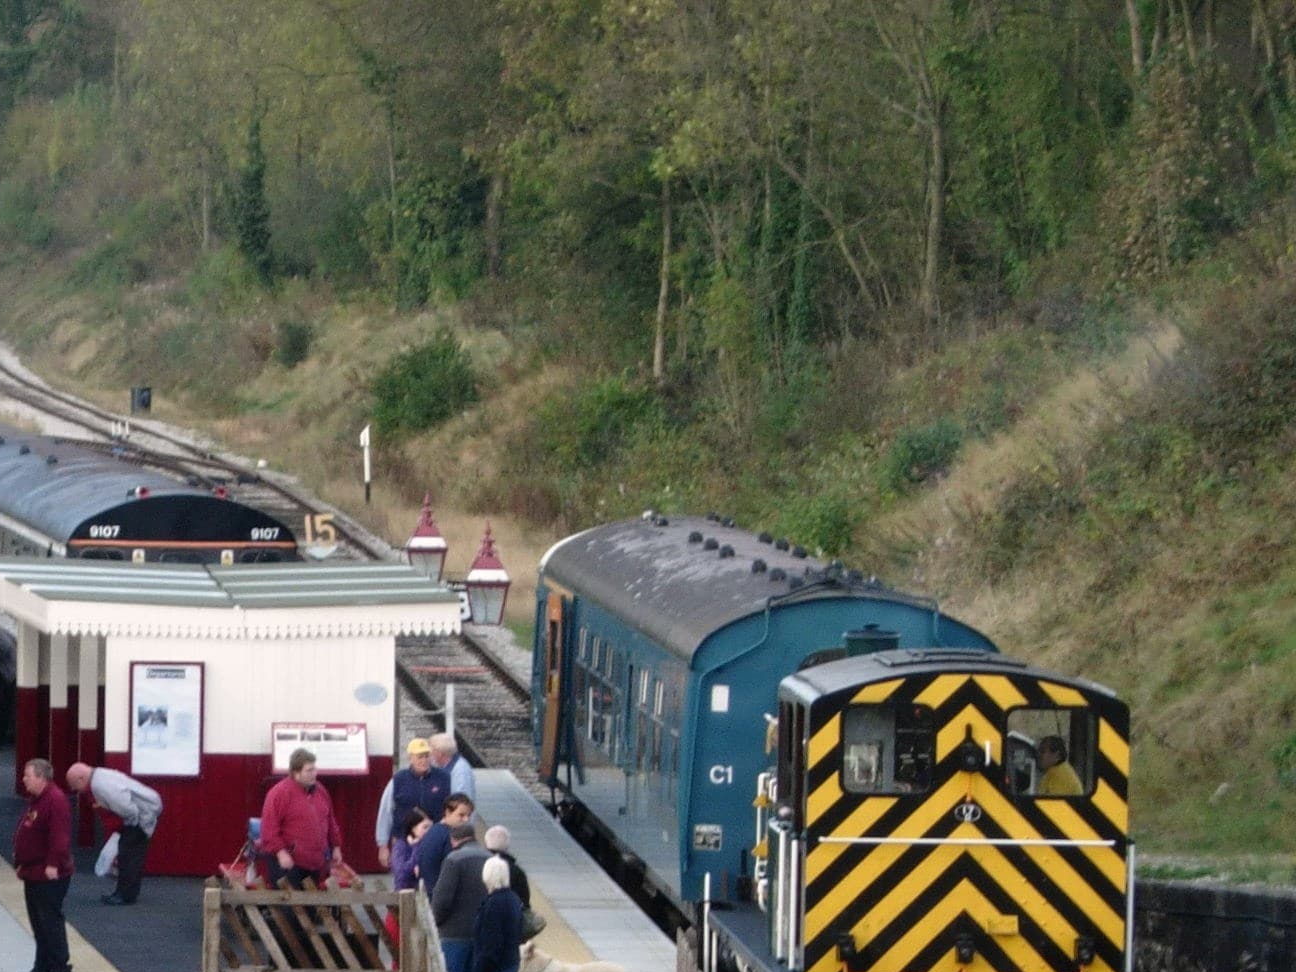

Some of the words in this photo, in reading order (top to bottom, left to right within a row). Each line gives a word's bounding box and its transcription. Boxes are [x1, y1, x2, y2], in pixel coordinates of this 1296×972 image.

[89, 525, 120, 538] 9107
[251, 527, 280, 540] 9107
[304, 514, 336, 546] 15
[709, 765, 733, 785] C1
